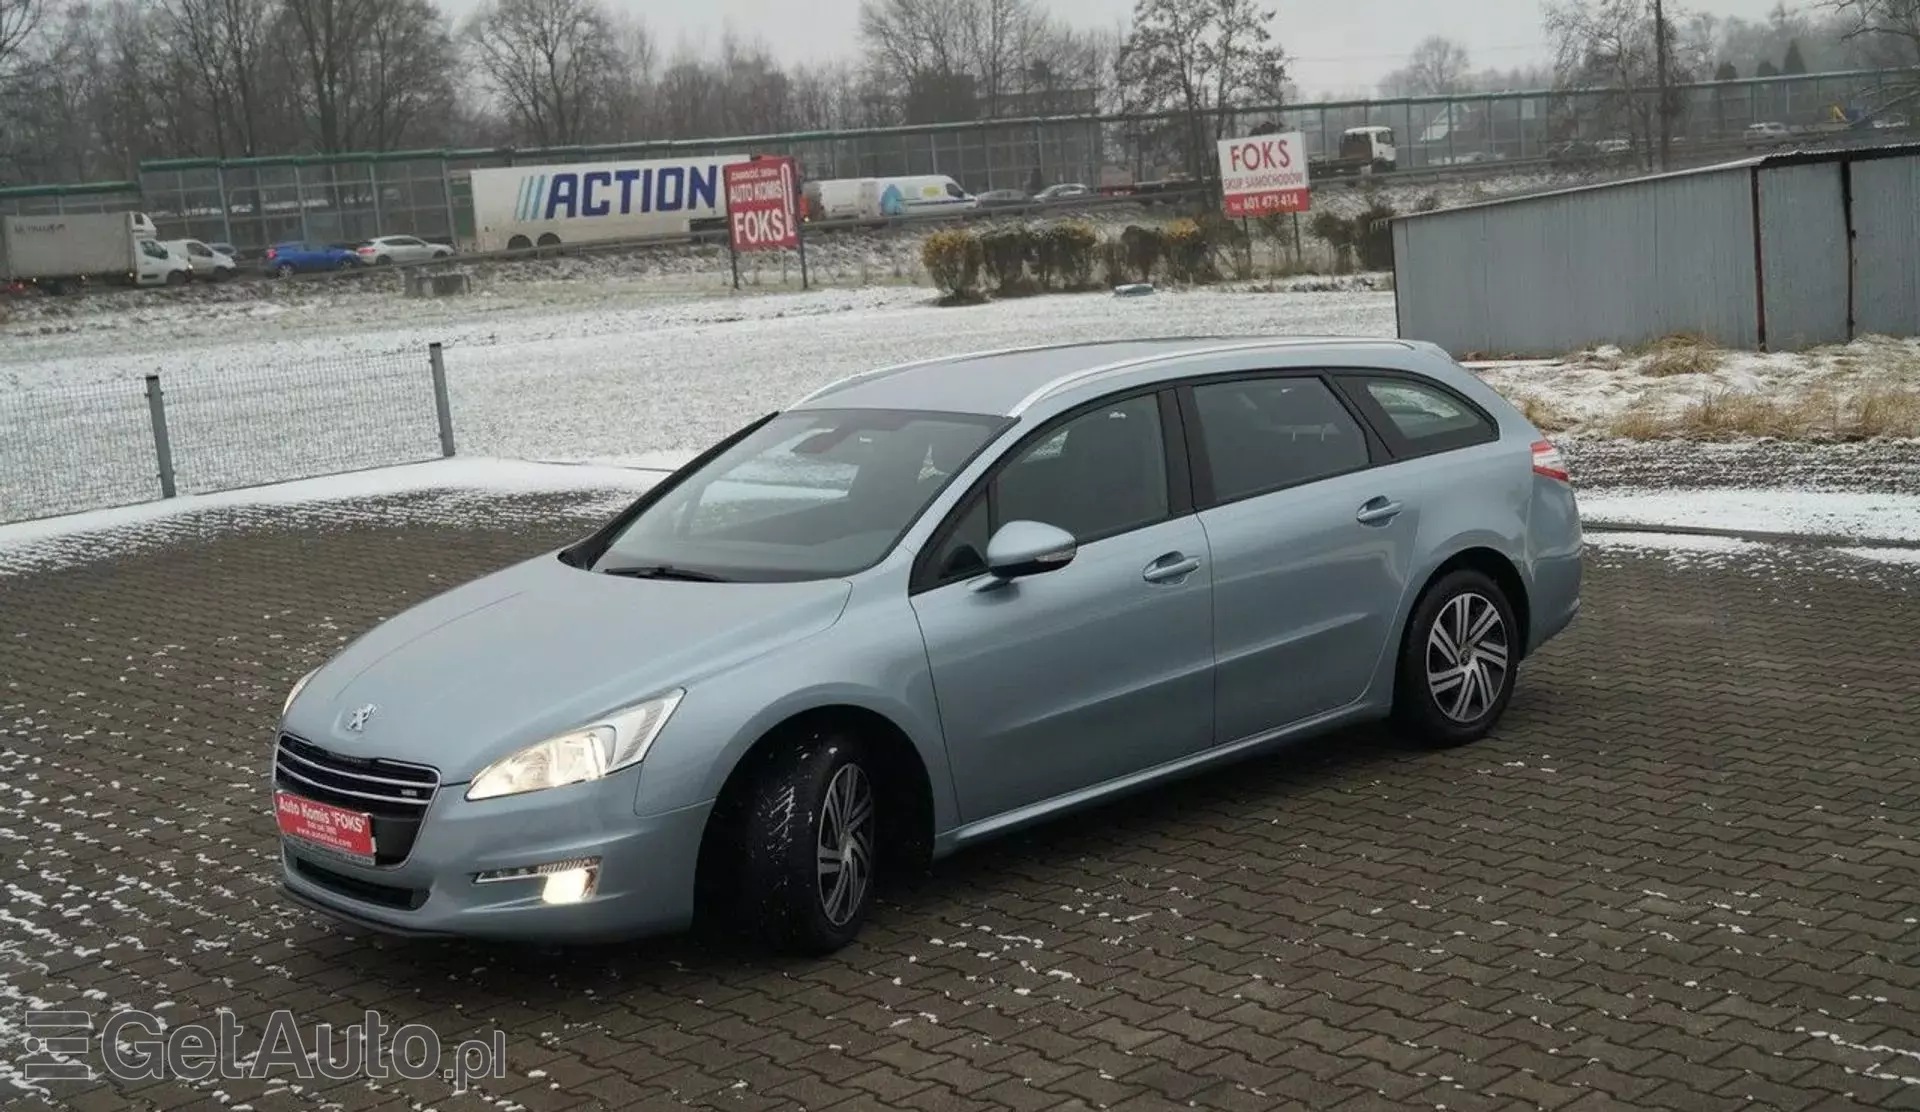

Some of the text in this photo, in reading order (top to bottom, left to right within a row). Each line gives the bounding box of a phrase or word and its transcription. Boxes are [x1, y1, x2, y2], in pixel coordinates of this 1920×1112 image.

[1230, 139, 1290, 172] FOKS
[544, 165, 717, 219] ACTION
[730, 179, 783, 204] AUTO KOMIS
[1223, 178, 1244, 190] SKUP
[733, 207, 785, 244] FOKS
[279, 796, 300, 815] Auto
[301, 802, 330, 824] Komis
